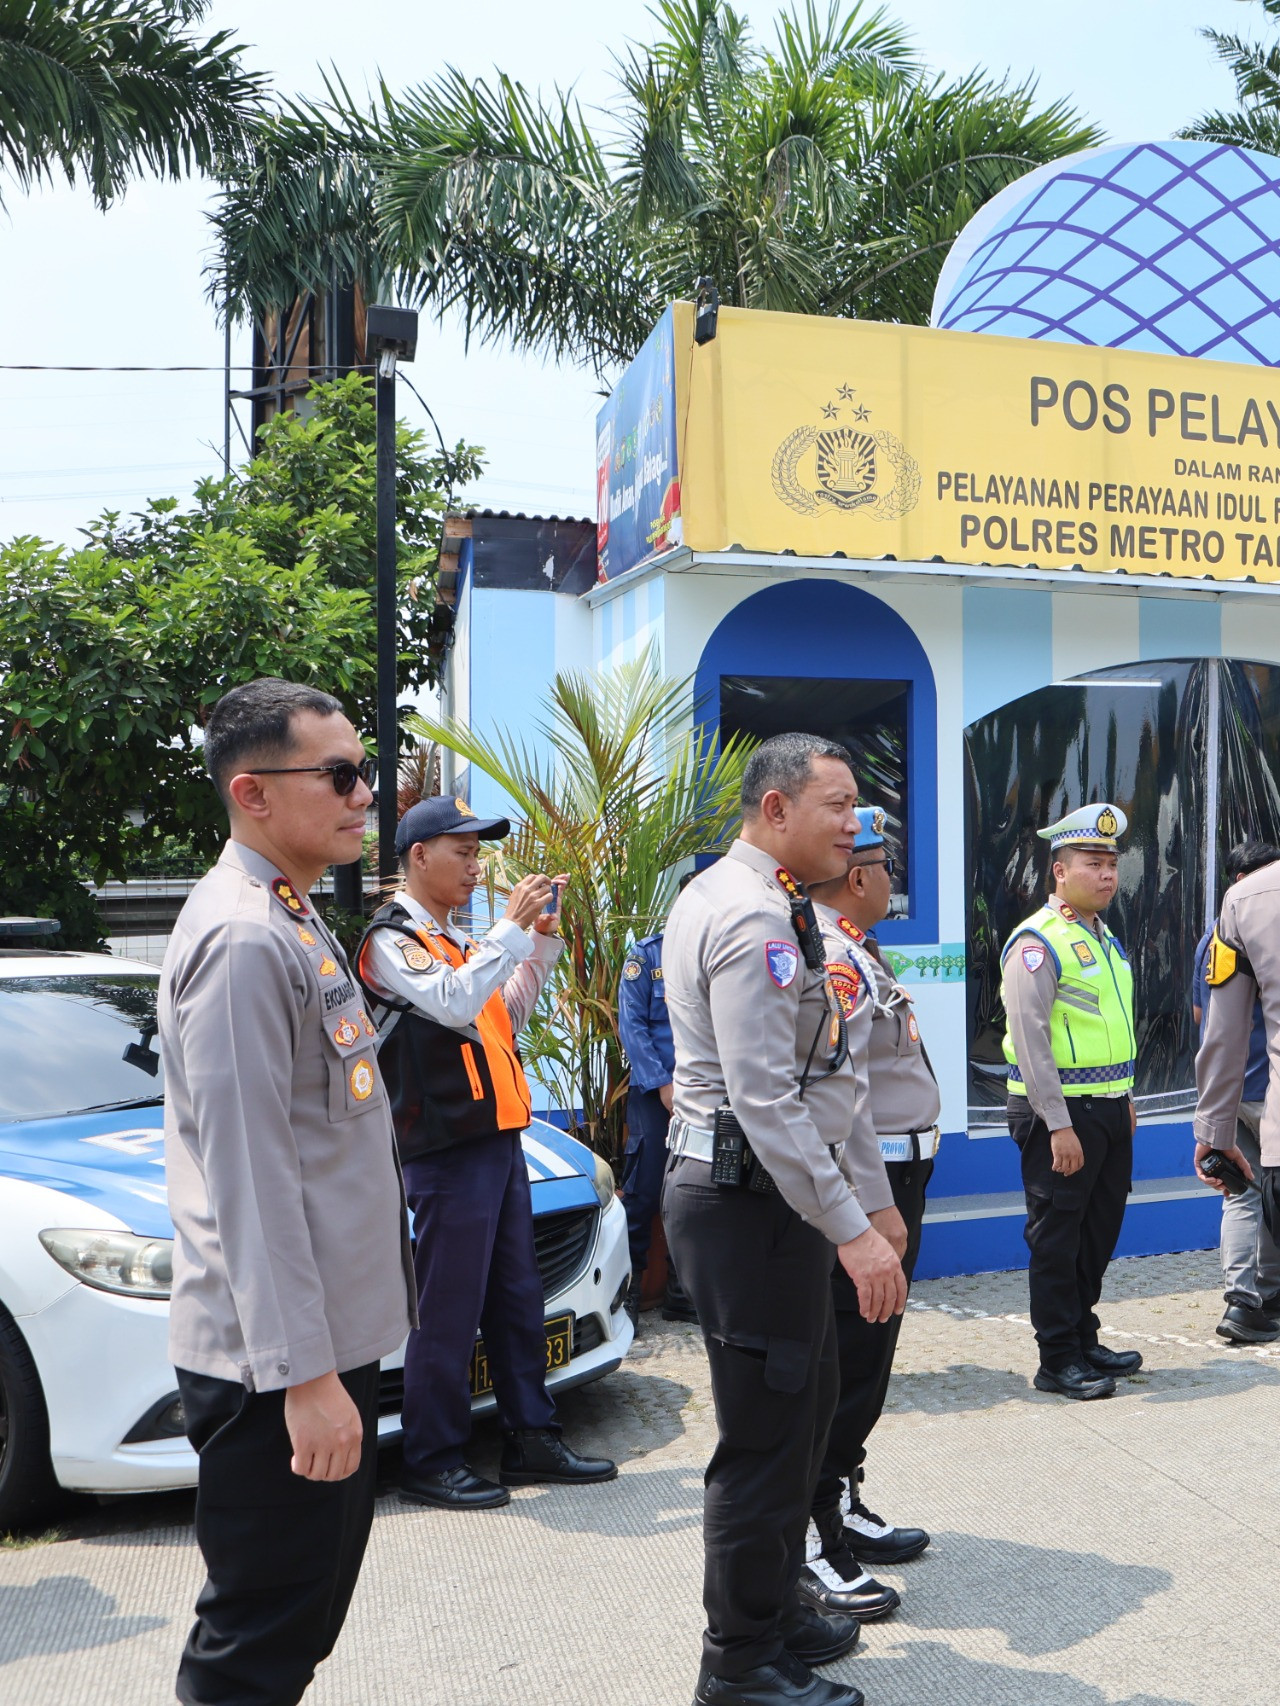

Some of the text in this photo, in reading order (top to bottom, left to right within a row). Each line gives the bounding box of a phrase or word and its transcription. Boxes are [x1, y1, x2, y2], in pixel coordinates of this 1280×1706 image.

[1030, 376, 1131, 434] POS
[1174, 458, 1242, 481] DALAM
[938, 471, 1079, 510] PELAYANAN
[1088, 482, 1208, 519] PERAYAAN
[1217, 492, 1267, 524] IDUL
[960, 514, 1098, 556] POLRES
[1110, 524, 1225, 563] METRO
[832, 980, 858, 991] ROPAM
[880, 1141, 906, 1155] PROVOS
